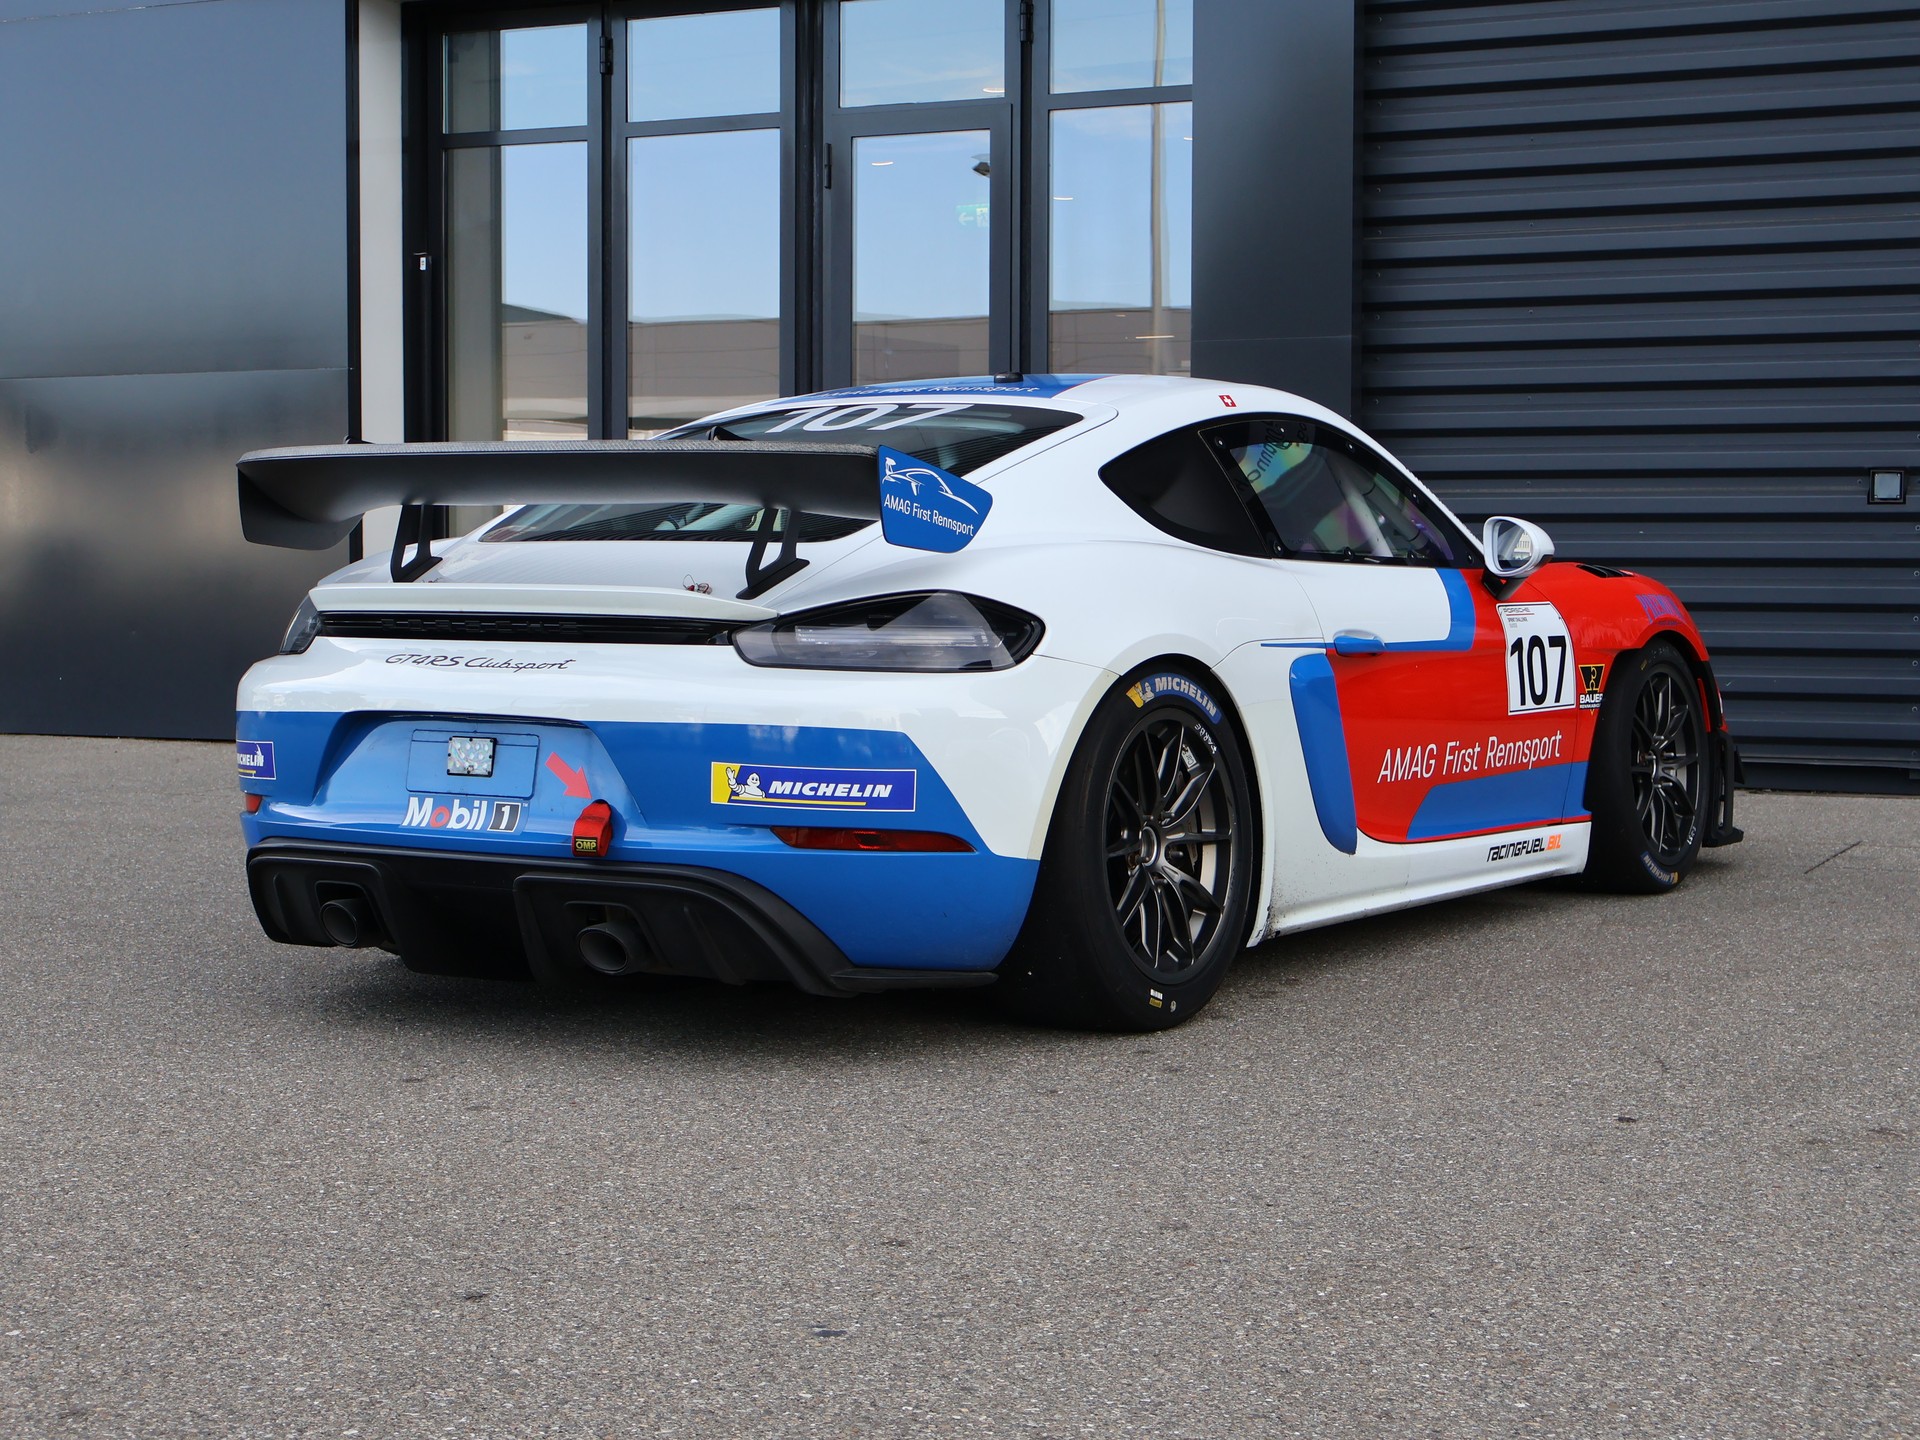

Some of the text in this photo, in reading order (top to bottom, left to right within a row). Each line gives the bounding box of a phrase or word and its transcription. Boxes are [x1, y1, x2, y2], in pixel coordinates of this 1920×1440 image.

[764, 404, 975, 433] 107
[884, 493, 974, 537] AMAG First Rennsport
[465, 656, 577, 673] Clubsport
[1510, 635, 1567, 706] 107
[1155, 676, 1217, 717] MICHELIN
[1377, 730, 1562, 783] AMAG First Rennsport
[768, 780, 893, 798] MICHELIN
[401, 796, 488, 831] Mobil
[575, 841, 597, 850] OMP
[1643, 854, 1670, 882] MICHELIN
